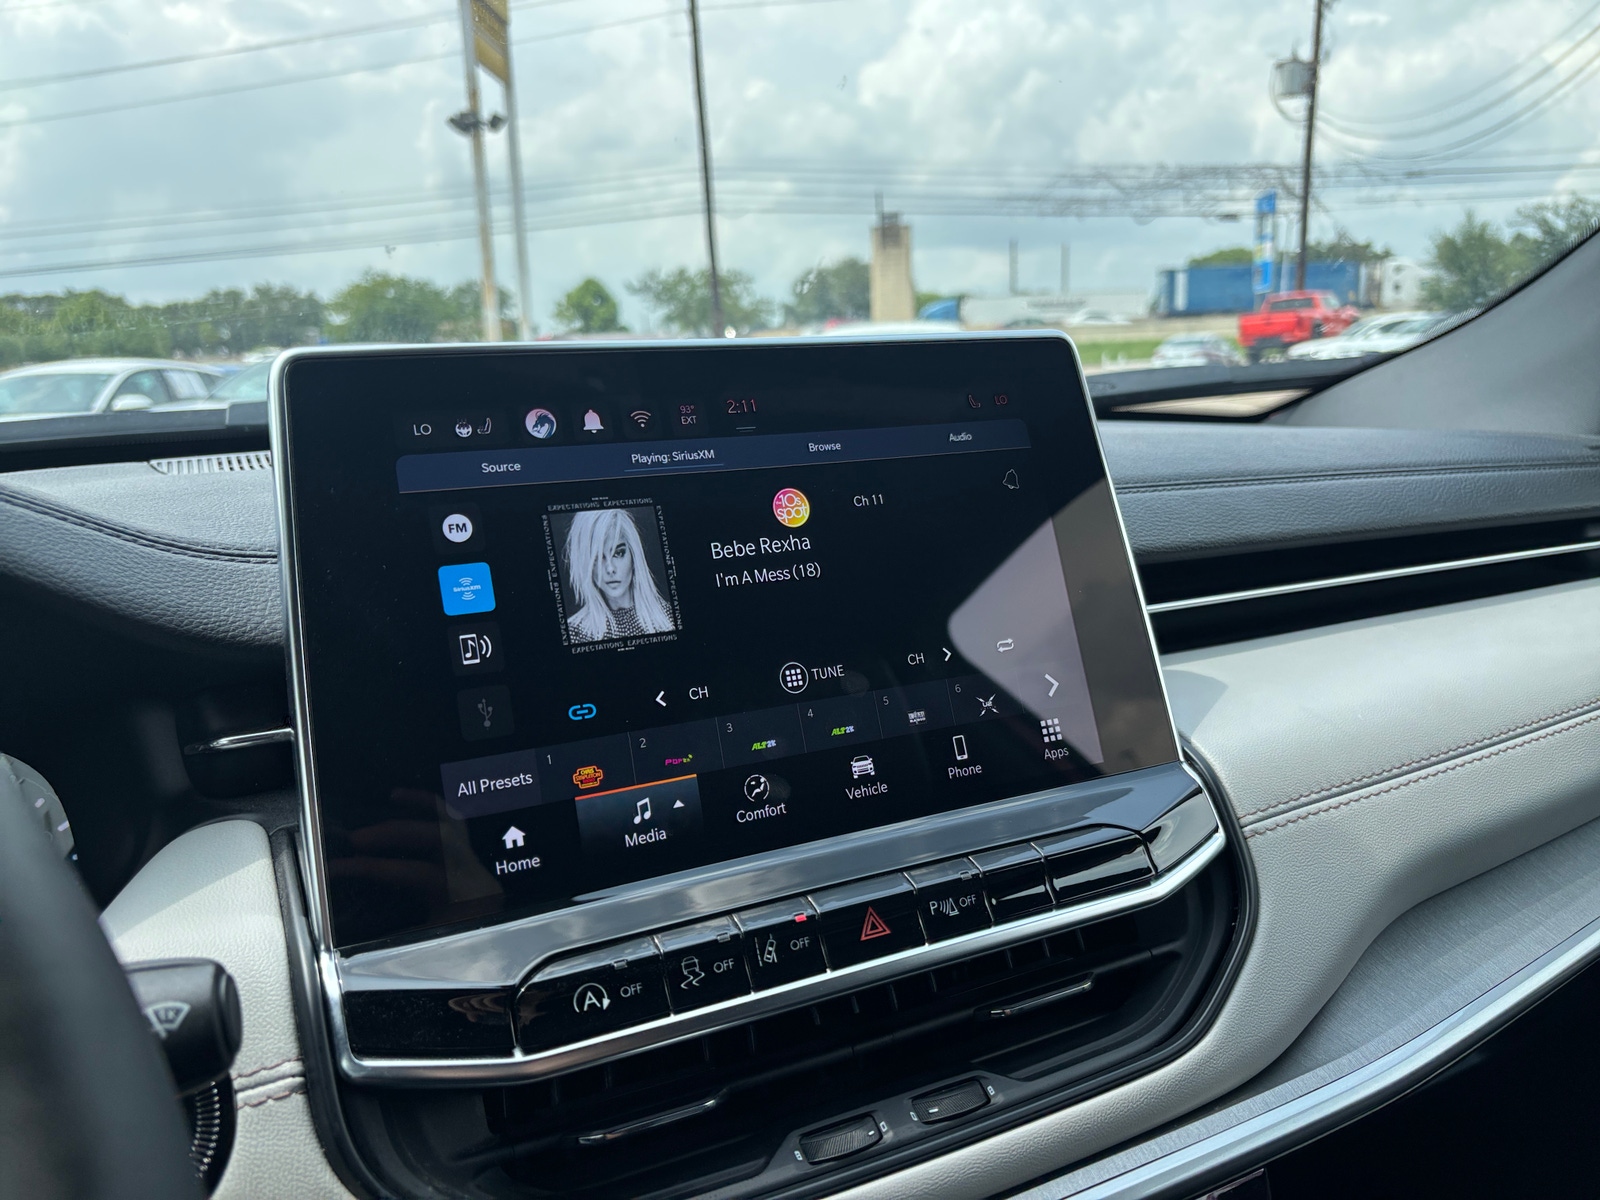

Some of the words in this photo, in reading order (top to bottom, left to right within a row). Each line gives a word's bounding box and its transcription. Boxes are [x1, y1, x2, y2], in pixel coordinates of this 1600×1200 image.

[726, 399, 757, 415] 2:11
[994, 394, 1008, 405] LO
[680, 415, 697, 426] EXT
[413, 423, 432, 437] LO
[949, 431, 973, 443] Audio
[808, 441, 842, 453] Browse
[631, 451, 671, 465] Playing:
[672, 449, 715, 462] SiriusXM
[481, 461, 521, 474] Source
[547, 501, 600, 512] EXPECTATIONS
[603, 498, 653, 508] EXPECTATIONS
[853, 494, 870, 507] Ch
[871, 493, 884, 506] 11
[776, 503, 808, 524] spot
[447, 523, 468, 535] FM
[710, 539, 757, 561] Bebe
[759, 534, 812, 555] Rexha
[715, 571, 740, 588] I'm
[741, 569, 753, 585] A
[754, 567, 791, 584] Mess
[792, 562, 822, 582] (18)
[907, 653, 925, 666] CH
[811, 664, 846, 681] TUNE
[688, 685, 710, 701] CH
[954, 683, 962, 694] 6
[882, 695, 890, 706] 5
[807, 708, 815, 719] 4
[725, 722, 734, 733] 3
[638, 737, 647, 749] 2
[547, 754, 553, 765] 1
[1044, 745, 1070, 761] Apps
[948, 762, 983, 779] Phone
[457, 781, 477, 798] All
[479, 771, 534, 793] Presets
[845, 780, 888, 801] Vehicle
[736, 802, 787, 823] Comfort
[624, 827, 667, 848] Media
[495, 854, 541, 876] Home
[959, 893, 977, 908] OFF
[789, 936, 811, 952] OFF
[713, 957, 735, 974] OFF
[620, 982, 643, 998] OFF
